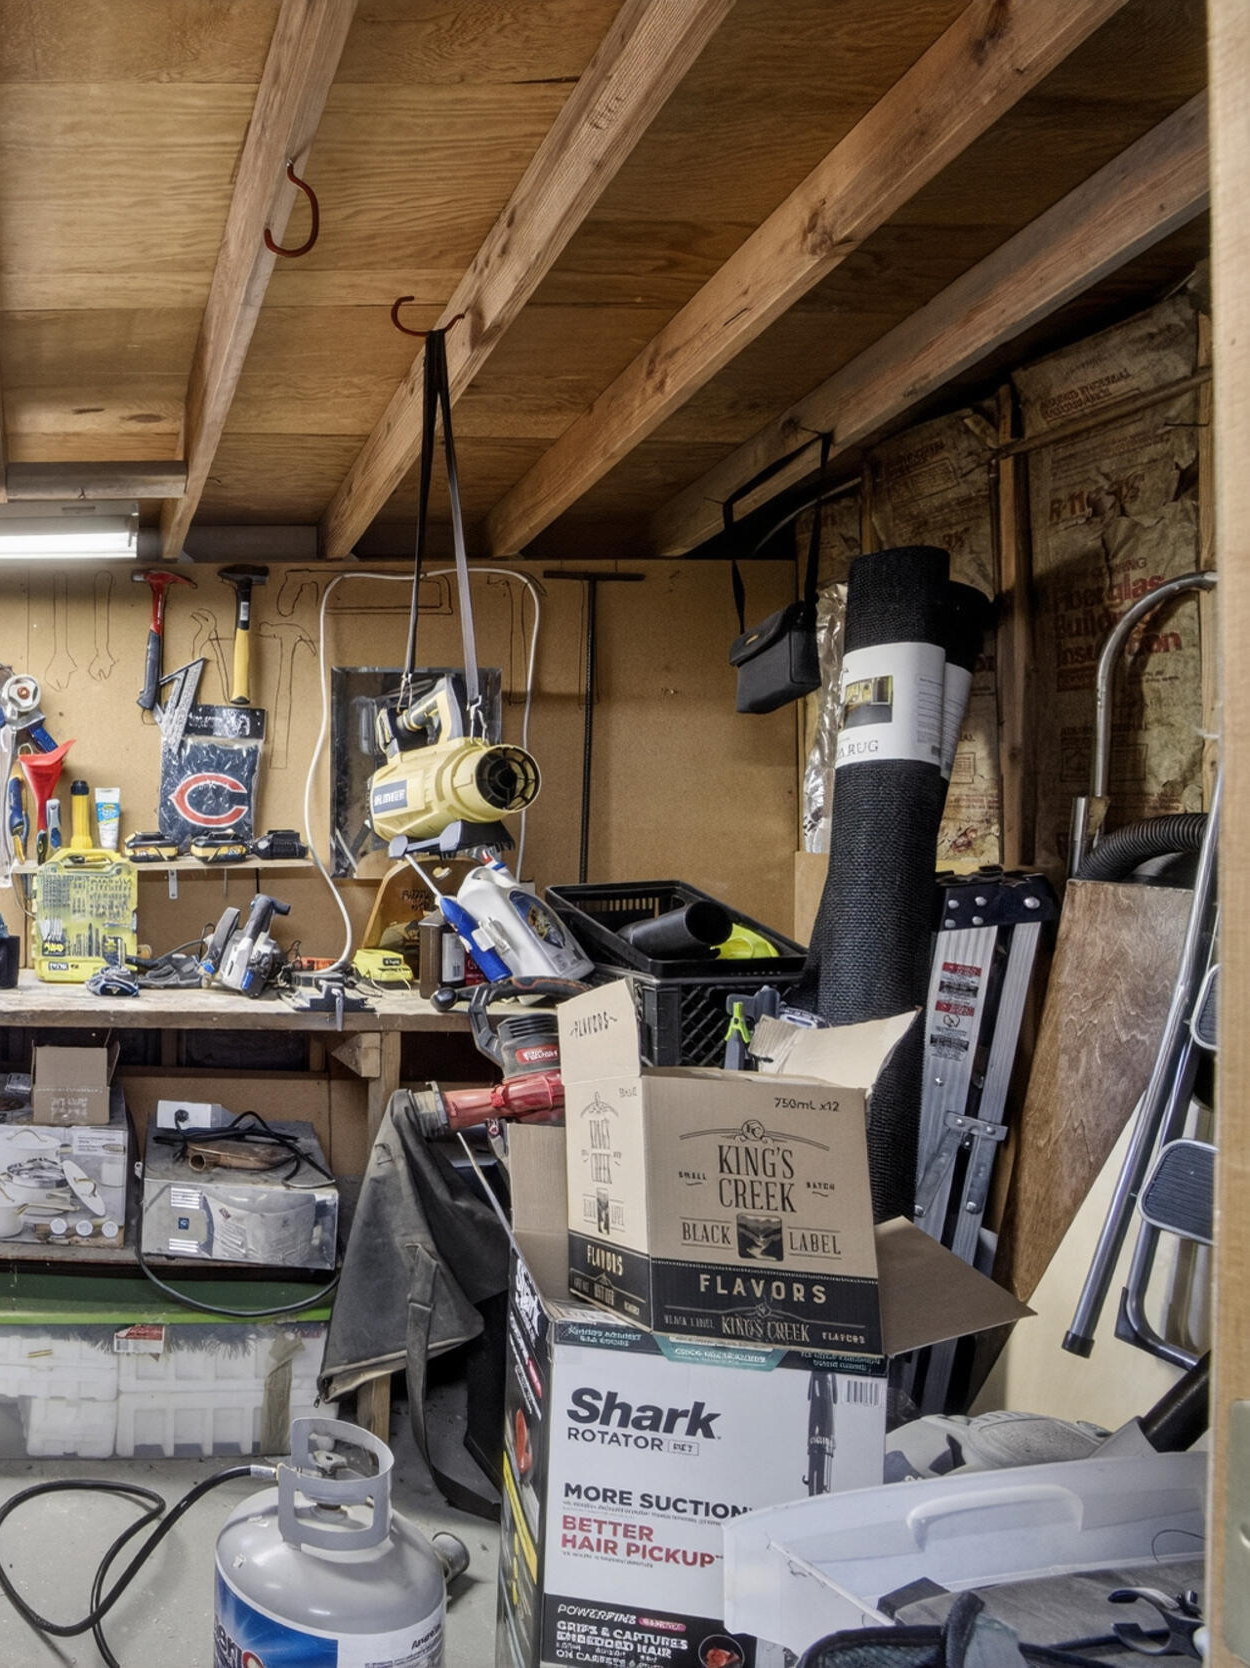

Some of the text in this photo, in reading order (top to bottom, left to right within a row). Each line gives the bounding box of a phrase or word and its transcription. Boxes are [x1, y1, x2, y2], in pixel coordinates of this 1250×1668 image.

[848, 739, 879, 756] RUG
[819, 1100, 840, 1112] x12
[718, 1145, 795, 1179] KING'S
[719, 1178, 797, 1213] CREEK
[682, 1222, 842, 1255] BLACK LABEL
[699, 1274, 827, 1304] FLAVORS
[566, 1387, 721, 1440] Shark
[567, 1426, 663, 1451] ROTATOR
[564, 1482, 633, 1506] MORE
[562, 1514, 654, 1542] BETTER
[561, 1533, 618, 1556] HAIR
[613, 1629, 689, 1650] CAPTURES
